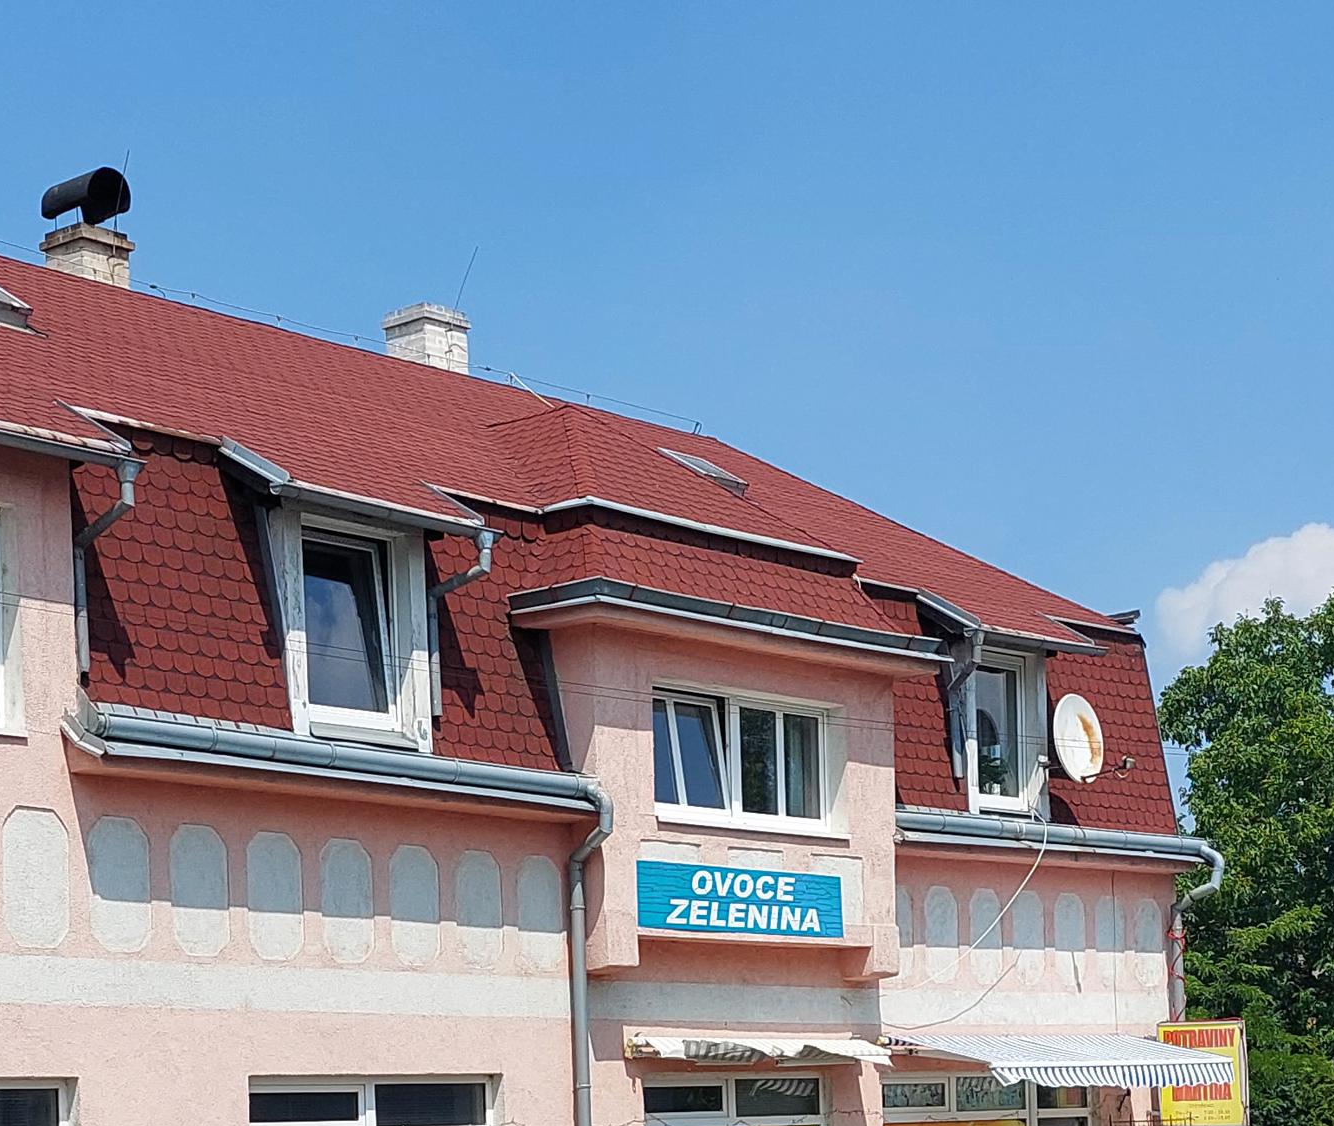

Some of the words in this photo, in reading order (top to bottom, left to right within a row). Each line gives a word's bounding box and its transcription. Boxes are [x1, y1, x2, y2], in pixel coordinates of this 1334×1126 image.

[692, 870, 796, 902] OVOCE
[666, 898, 821, 932] ZELENINA
[1163, 1028, 1235, 1048] POTRAVINY
